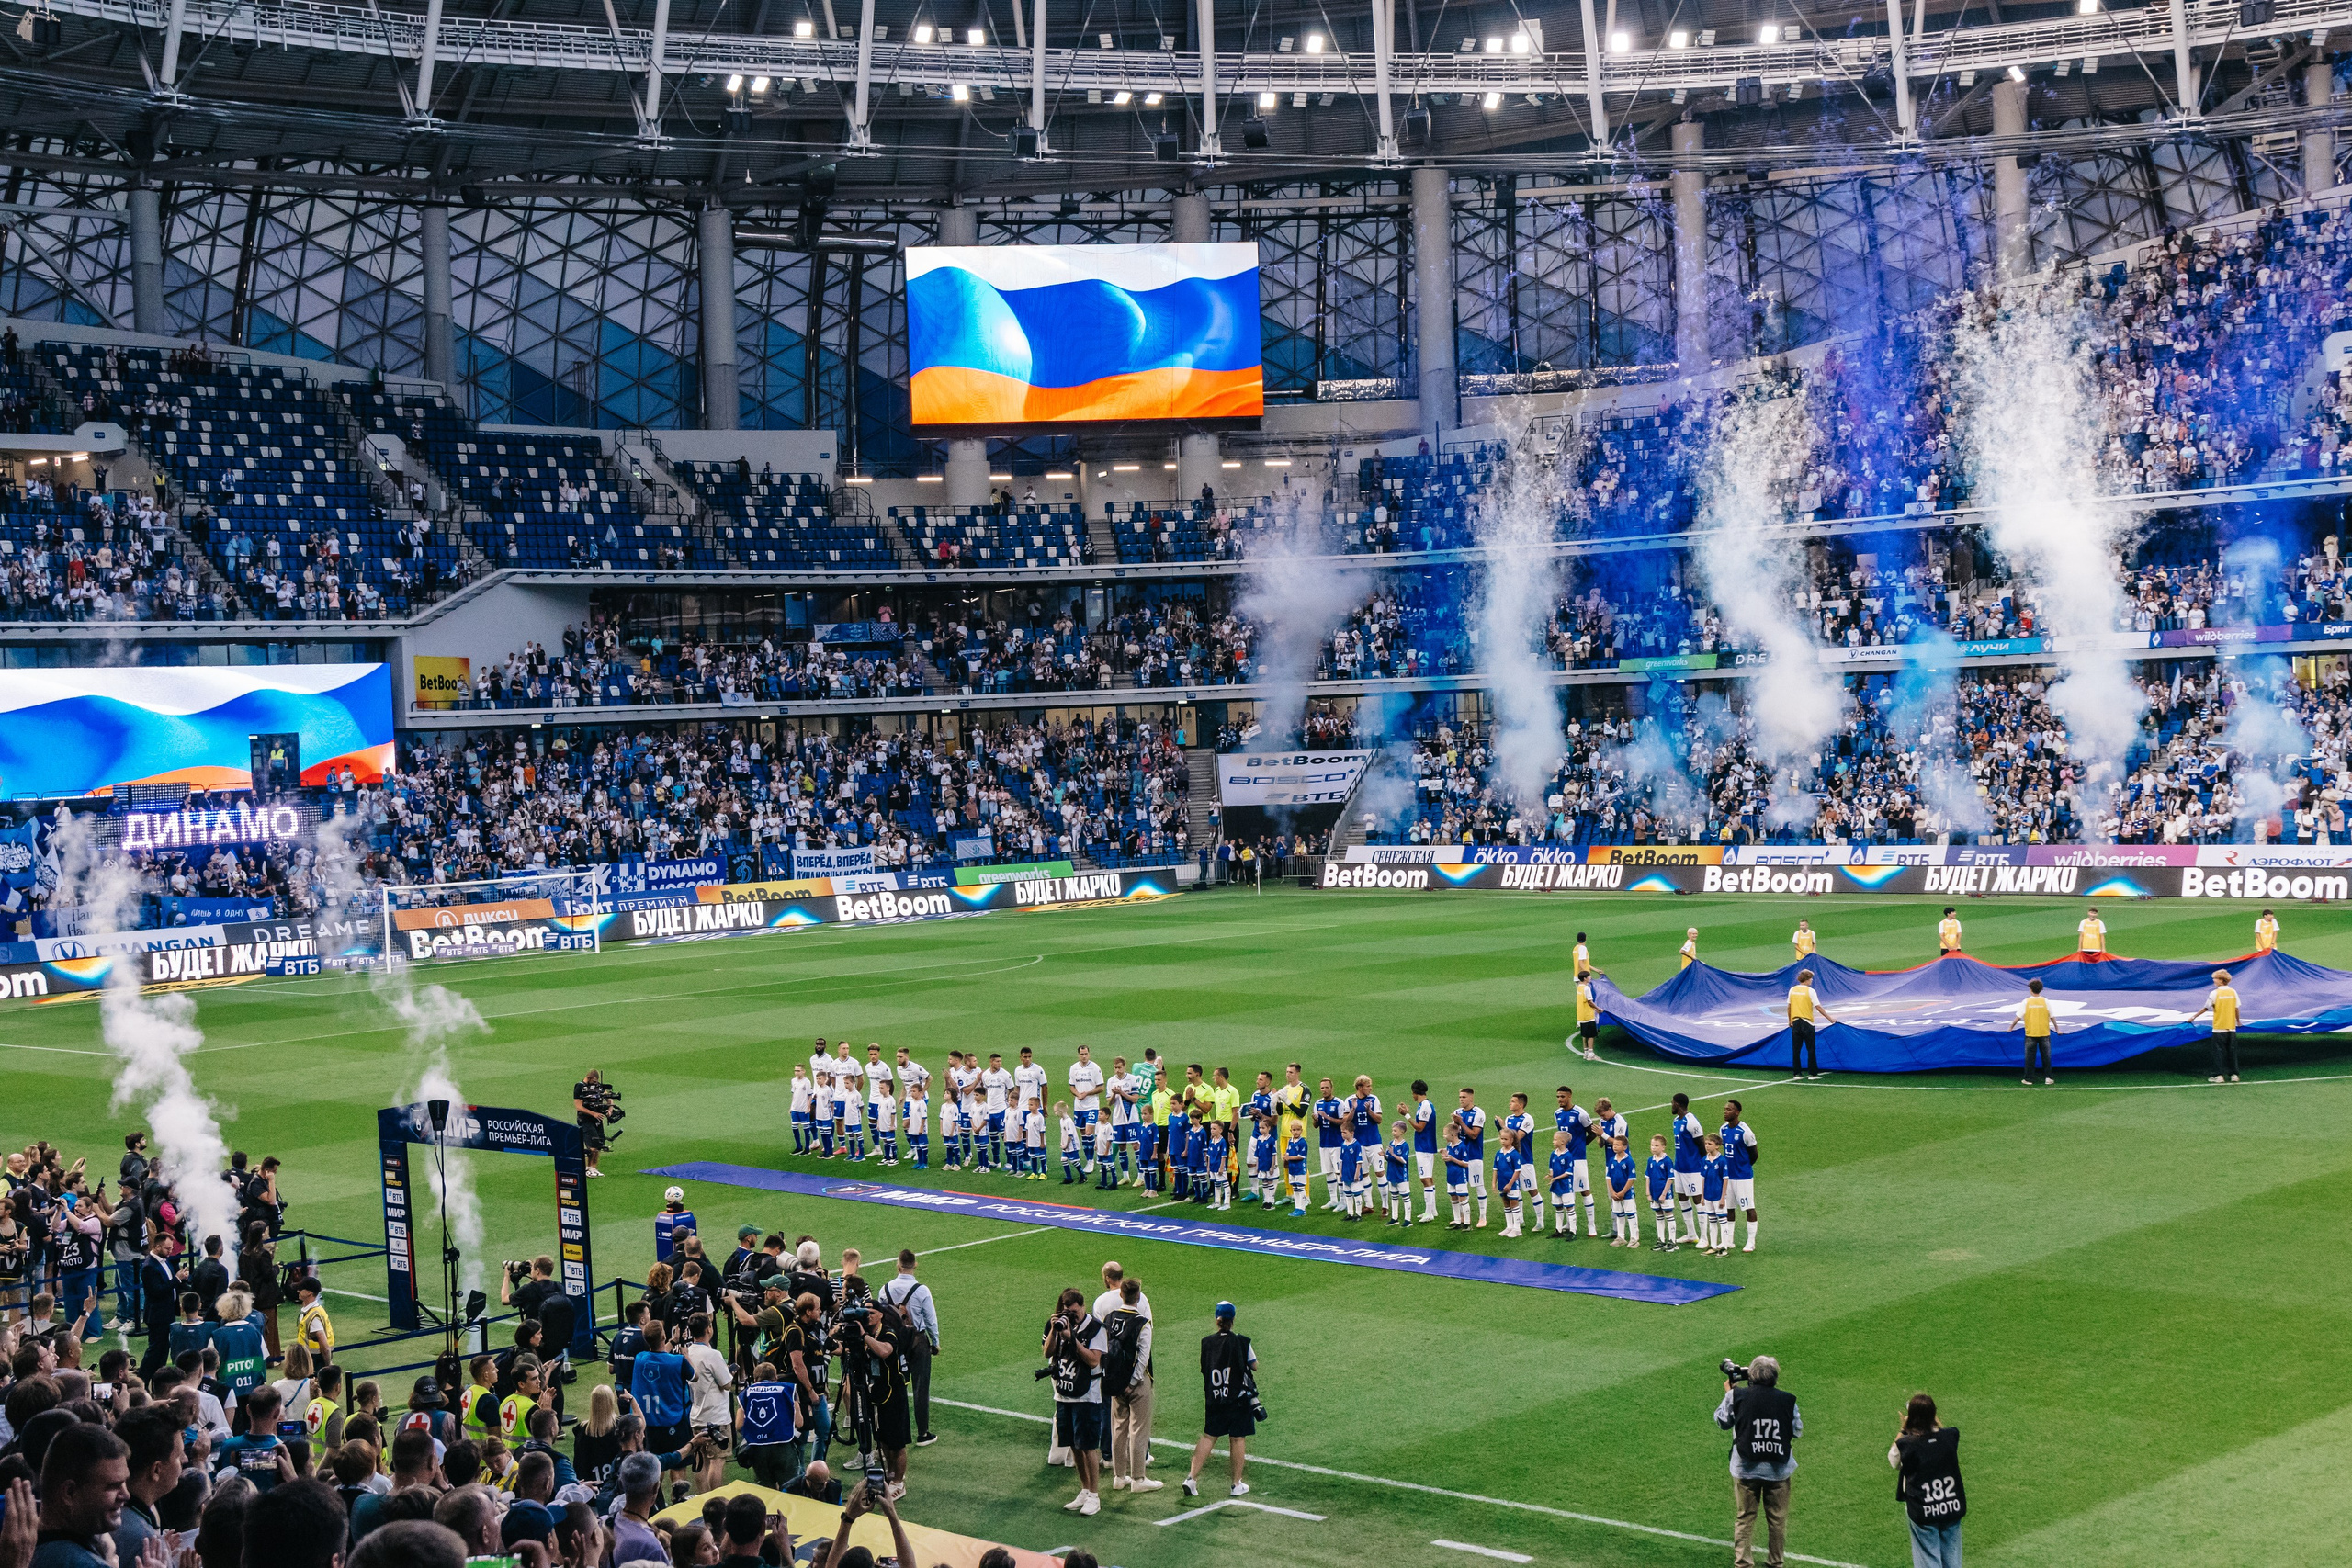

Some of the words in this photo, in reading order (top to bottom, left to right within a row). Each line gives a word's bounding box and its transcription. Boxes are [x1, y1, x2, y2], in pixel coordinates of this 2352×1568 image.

[2195, 630, 2256, 642] wildberries
[2324, 625, 2351, 636] Брит
[1860, 649, 1897, 657] CHANGAN
[1645, 659, 1689, 669] greenworks
[420, 674, 459, 691] BetBoo
[1246, 754, 1367, 767] BetBoom
[1229, 773, 1347, 785] BOSCO
[1292, 790, 1345, 803] ВТБ
[121, 807, 300, 851] ДИНАМО
[836, 852, 872, 867] ВПЕРЁД
[1372, 850, 1435, 863] СЕНЕЖСКАЯ
[1610, 850, 1698, 864] BetBoom
[1897, 853, 1930, 865] ВТБ
[1975, 853, 2010, 866] ВТБ
[2054, 850, 2167, 867] wildberries
[2248, 858, 2334, 866] АЭРОФЛОТ
[648, 862, 717, 881] DYNAMO
[978, 866, 1051, 885] greenworks
[1323, 863, 1429, 888] BetBoom
[1501, 865, 1555, 890] БУДЕТ
[1554, 865, 1623, 888] ЖАРКО
[1703, 865, 1834, 893] BetBoom
[1924, 866, 1994, 894] БУДЕТ
[1992, 866, 2078, 893] ЖАРКО
[2181, 868, 2348, 899] BetBoom
[721, 887, 813, 904] BetBoom
[1015, 877, 1062, 905] БУДЕТ
[1064, 874, 1121, 900] ЖАРКО
[618, 897, 689, 911] ПРЕМИУМ
[836, 892, 952, 921] BetBoom
[633, 906, 691, 936] БУДЕТ
[695, 901, 764, 931] ЖАРКО
[410, 925, 551, 959] BetBoom
[560, 933, 593, 949] ВТБ
[447, 947, 462, 955] ВТБ
[472, 945, 488, 953] ВТБ
[498, 943, 514, 953] ВТБ
[152, 946, 226, 981] БУДЕТ
[358, 956, 375, 964] ВТБ
[284, 959, 319, 976] ВТБ
[487, 1119, 544, 1134] РОССИЙСКАЯ
[488, 1131, 552, 1146] ПРЕМЬЕР-ЛИГА
[1473, 1174, 1480, 1183] 17
[1523, 1179, 1532, 1188] 19
[1688, 1183, 1696, 1192] 16
[392, 1192, 402, 1201] ВТБ
[1740, 1197, 1748, 1207] 91
[387, 1207, 406, 1218] МИР
[568, 1213, 579, 1223] ВТБ
[394, 1226, 404, 1235] ВТБ
[561, 1228, 582, 1240] МИР
[977, 1203, 1184, 1233] РОССИЙСКАЯ
[1185, 1228, 1432, 1265] ПРЕМЬЕР-ЛИГА
[397, 1260, 407, 1269] ВТБ
[571, 1267, 582, 1276] ВТБ
[236, 1376, 252, 1387] 011
[1753, 1418, 1781, 1440] 172
[1921, 1475, 1956, 1503] 182
[1923, 1499, 1961, 1517] PHOTO
